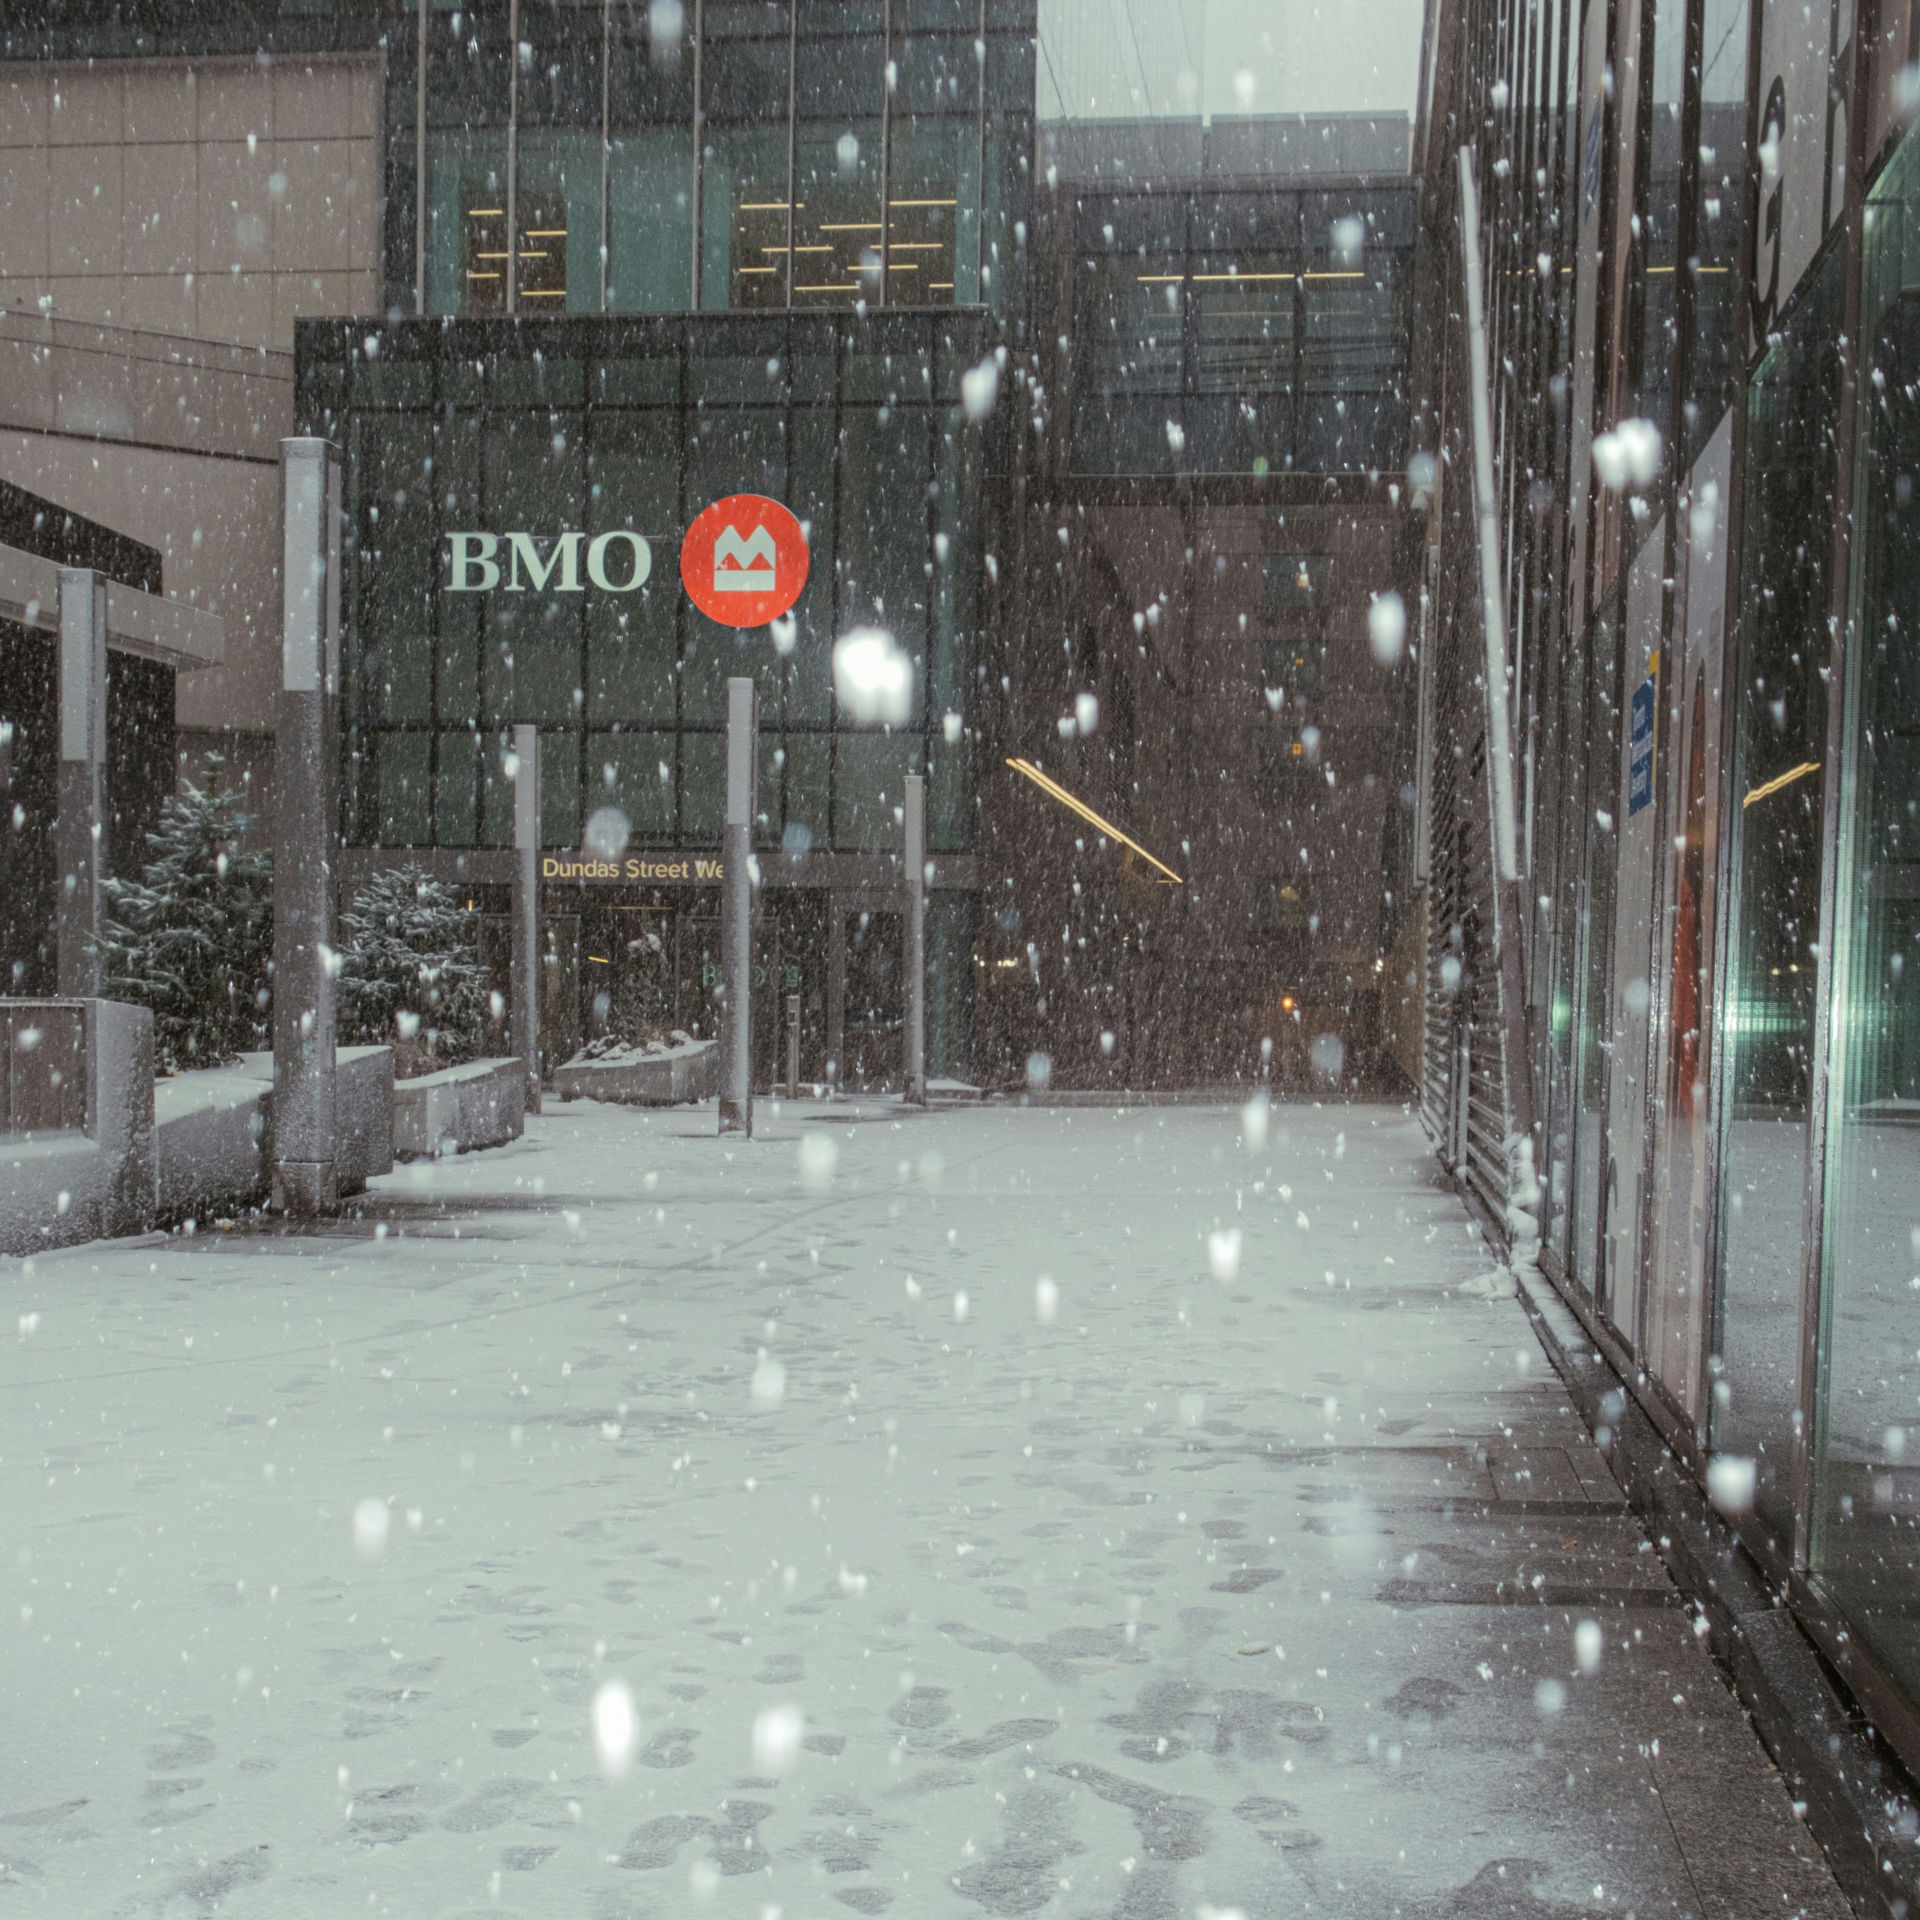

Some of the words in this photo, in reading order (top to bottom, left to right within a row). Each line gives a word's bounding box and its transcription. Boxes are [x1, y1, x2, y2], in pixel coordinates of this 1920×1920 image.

[444, 531, 652, 592] BMO
[543, 857, 620, 878] Dundas
[626, 857, 690, 879] Street
